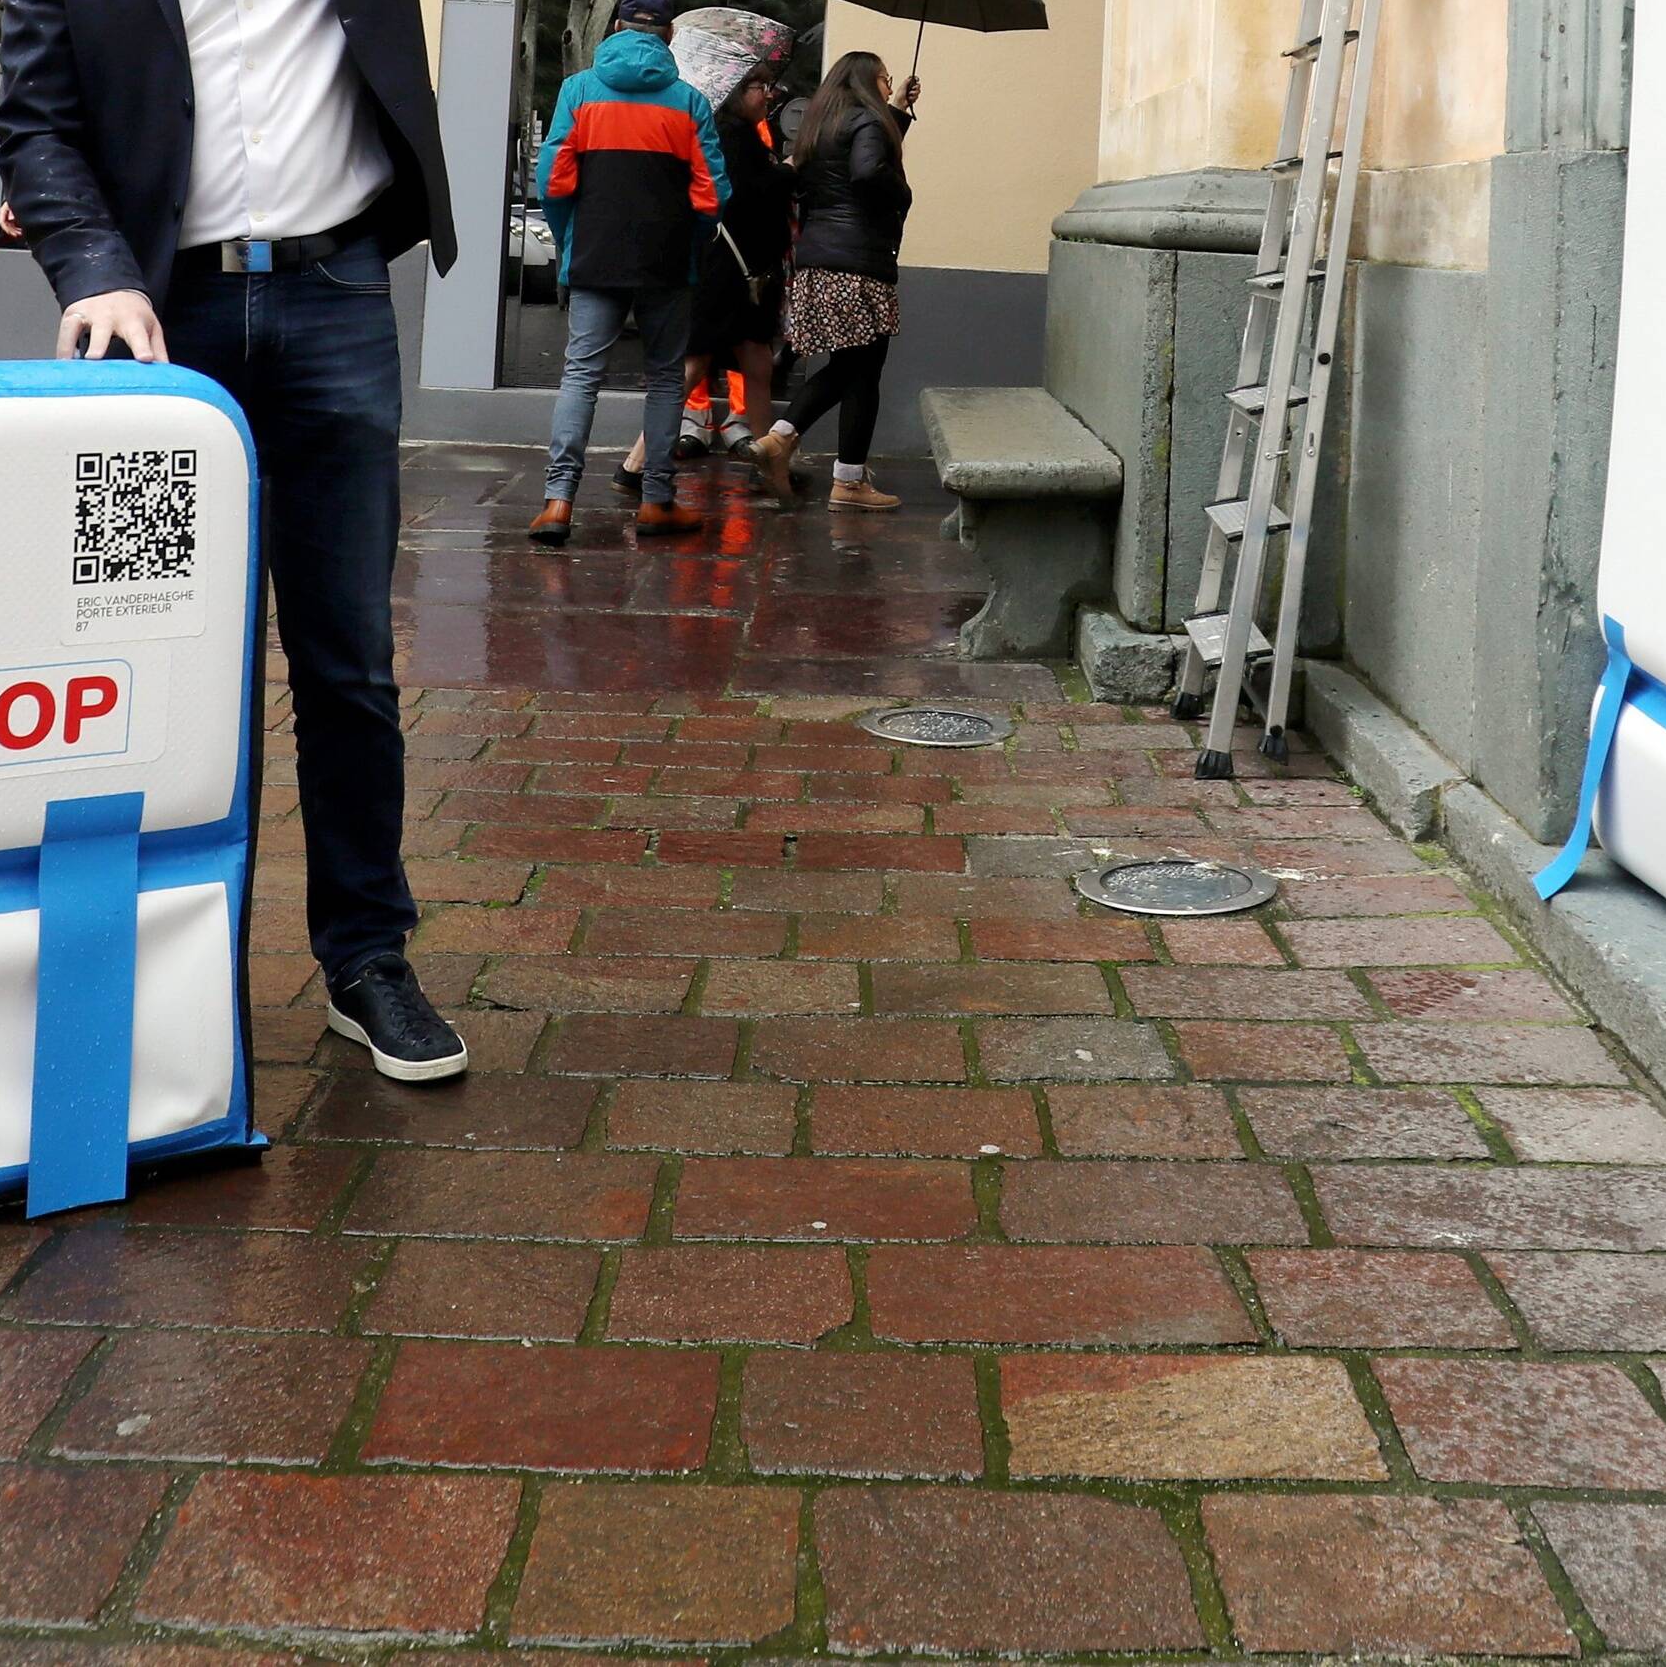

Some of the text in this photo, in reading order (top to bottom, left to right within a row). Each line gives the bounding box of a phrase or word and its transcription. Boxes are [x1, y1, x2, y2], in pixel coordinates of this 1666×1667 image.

[77, 590, 194, 608] ERIC VANDERHAEGHE
[76, 603, 173, 619] PORTE EXTERIEUR
[75, 621, 89, 632] 87
